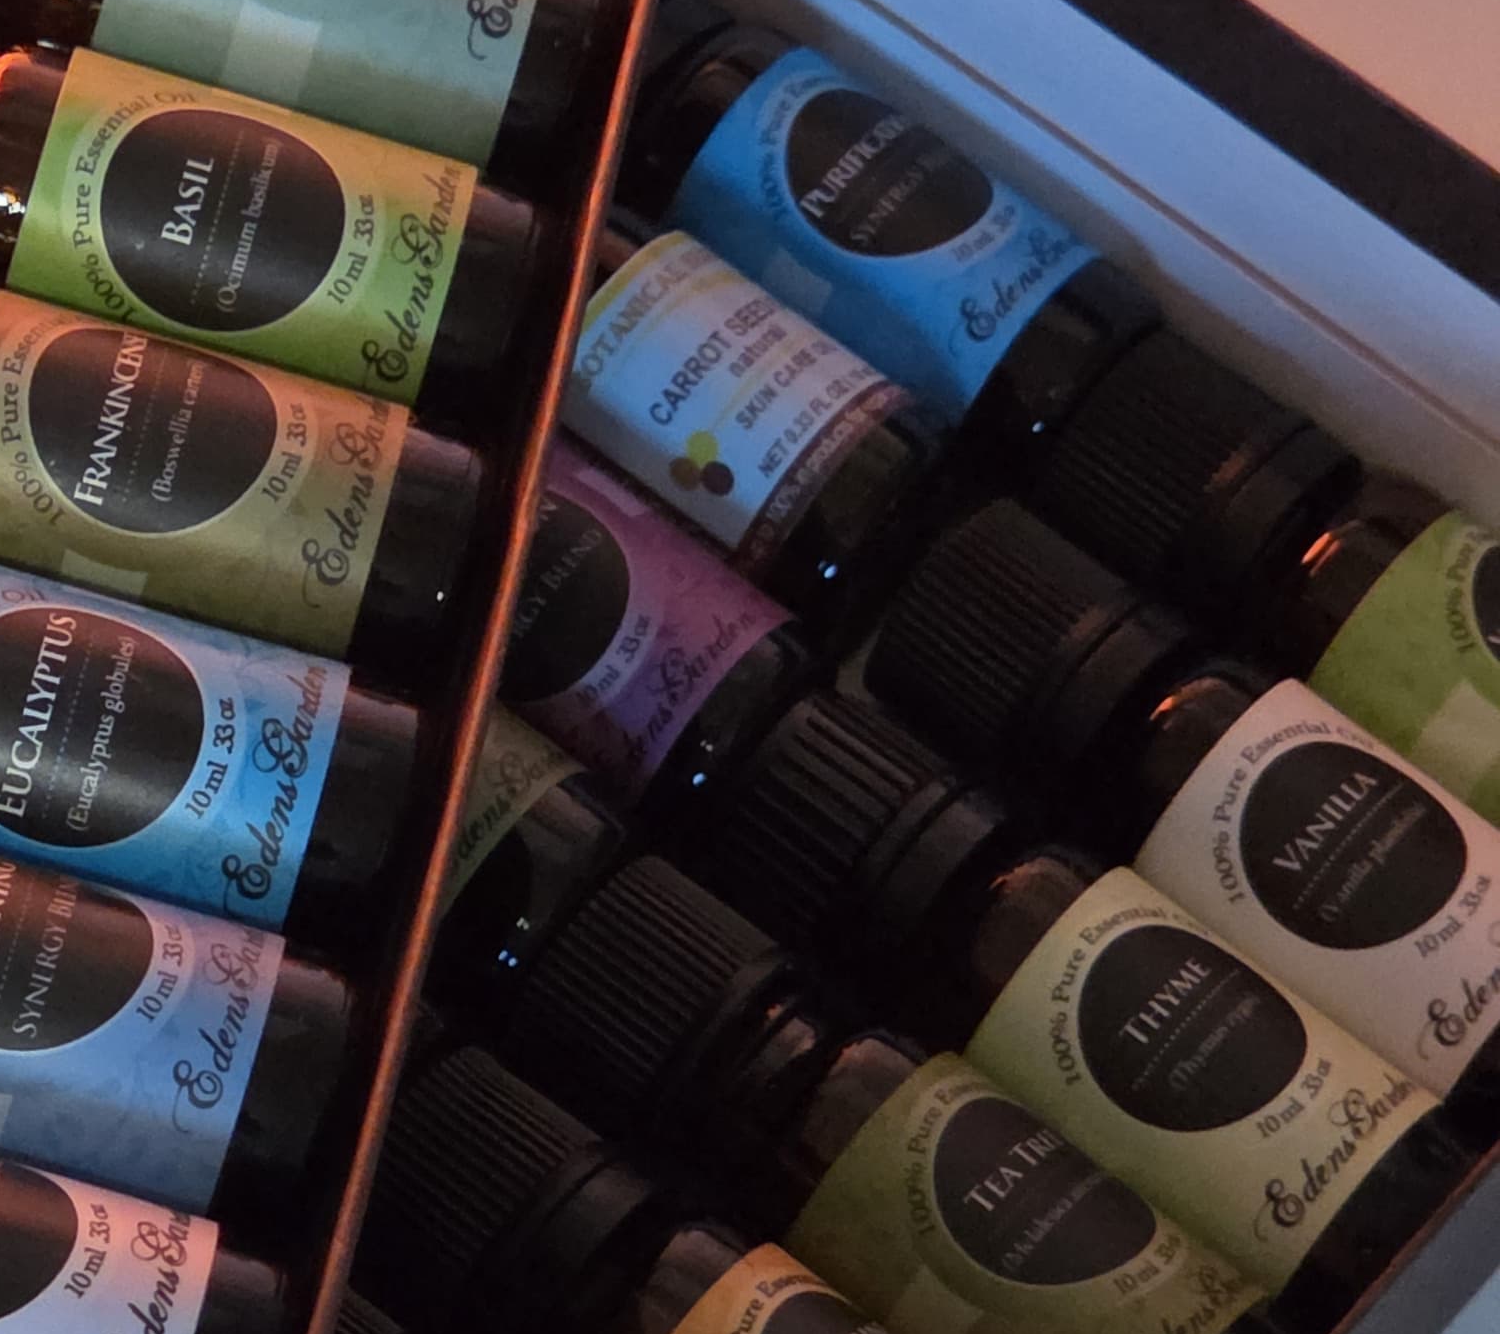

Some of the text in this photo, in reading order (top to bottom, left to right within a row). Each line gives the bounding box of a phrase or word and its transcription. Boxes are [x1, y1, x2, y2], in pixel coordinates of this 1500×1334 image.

[74, 96, 157, 175] Essential
[72, 183, 92, 249] Pure
[161, 156, 215, 247] BASIL
[214, 217, 259, 313] (Ocimum
[325, 278, 353, 306] 10
[347, 254, 369, 284] ml
[361, 271, 434, 384] Edens
[728, 324, 788, 378] natural
[649, 330, 732, 426] CARROT
[736, 345, 818, 430] SKIN CARE
[0, 383, 67, 527] 100% Pure
[150, 407, 197, 503] (Boswellia
[757, 439, 790, 478] NET
[300, 472, 375, 609] Edens
[65, 634, 140, 834] (Eucalyptus globules)
[184, 789, 213, 821] 10
[205, 762, 230, 796] ml
[219, 697, 237, 721] oz
[220, 666, 329, 912] Edens Garden
[1212, 721, 1332, 905] 100% Pure Essential
[1272, 772, 1381, 872] VANILLA
[135, 994, 163, 1025] 10
[156, 970, 180, 1000] ml
[1050, 905, 1168, 1088] 100% Pure Essential
[1118, 956, 1213, 1047] THYME
[171, 991, 252, 1135] Edens
[907, 1105, 943, 1158] Pure
[964, 1164, 1024, 1214] TEA
[1252, 1135, 1357, 1242] Edens
[63, 1272, 92, 1301] 10
[83, 1248, 107, 1278] ml
